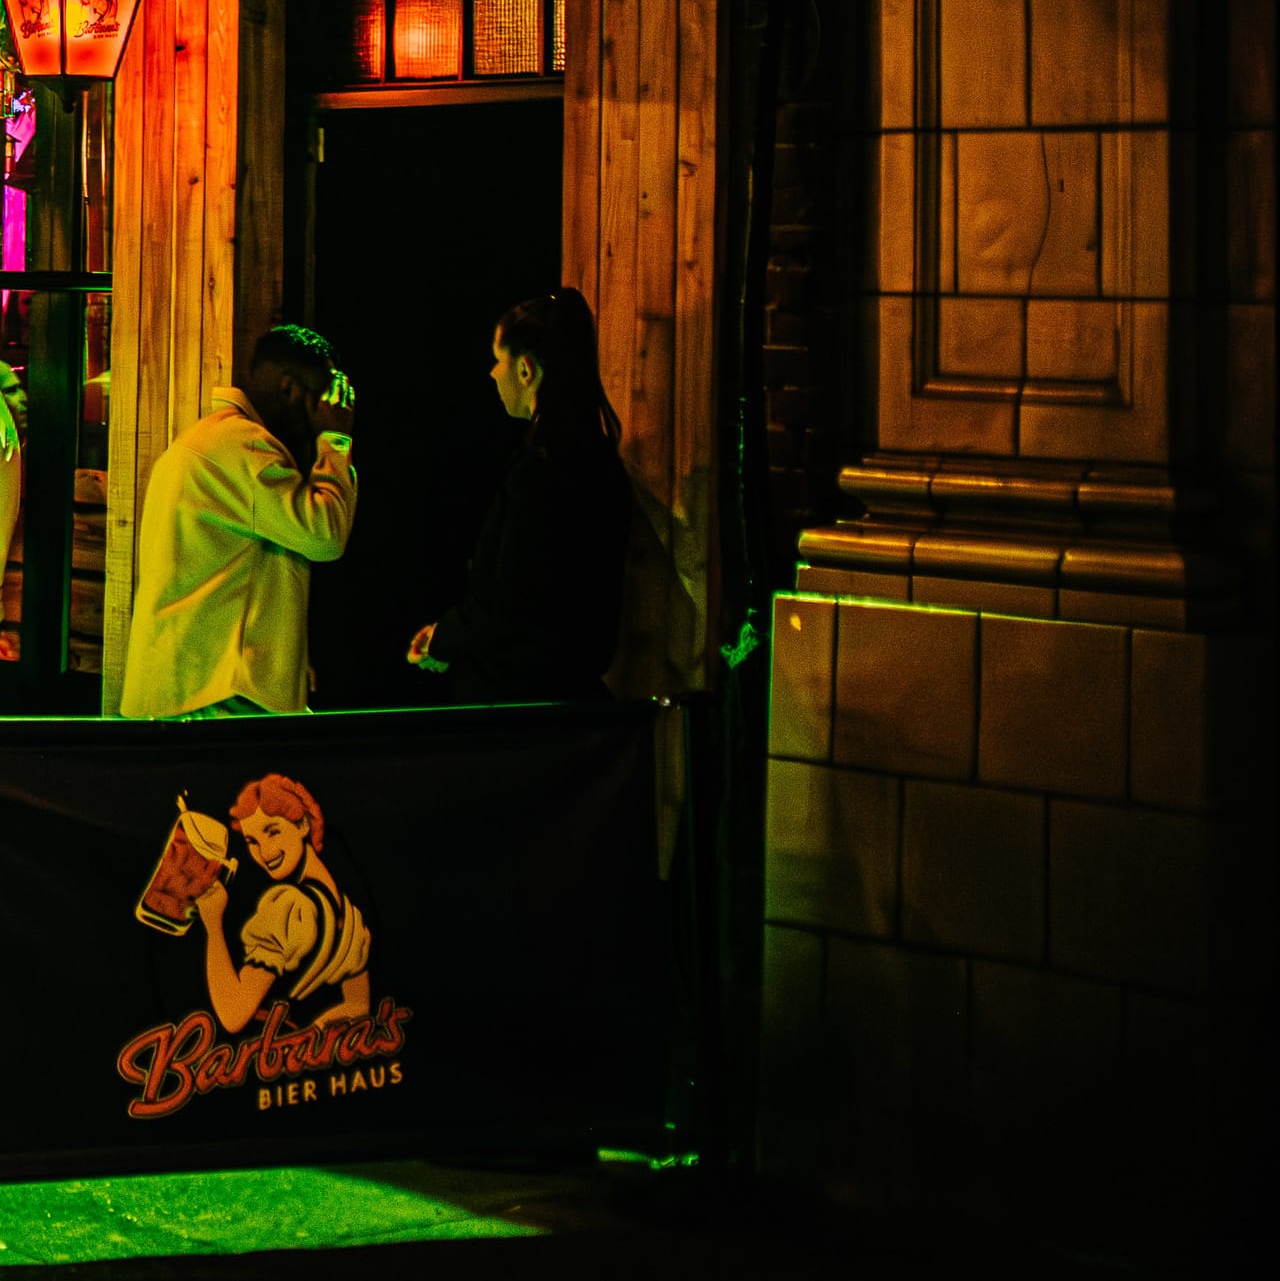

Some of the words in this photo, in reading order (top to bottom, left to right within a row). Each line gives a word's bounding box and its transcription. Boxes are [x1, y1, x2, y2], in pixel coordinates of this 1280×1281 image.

[117, 997, 414, 1118] Barbara's
[258, 1080, 317, 1110] BIER
[330, 1062, 403, 1096] HAUS
